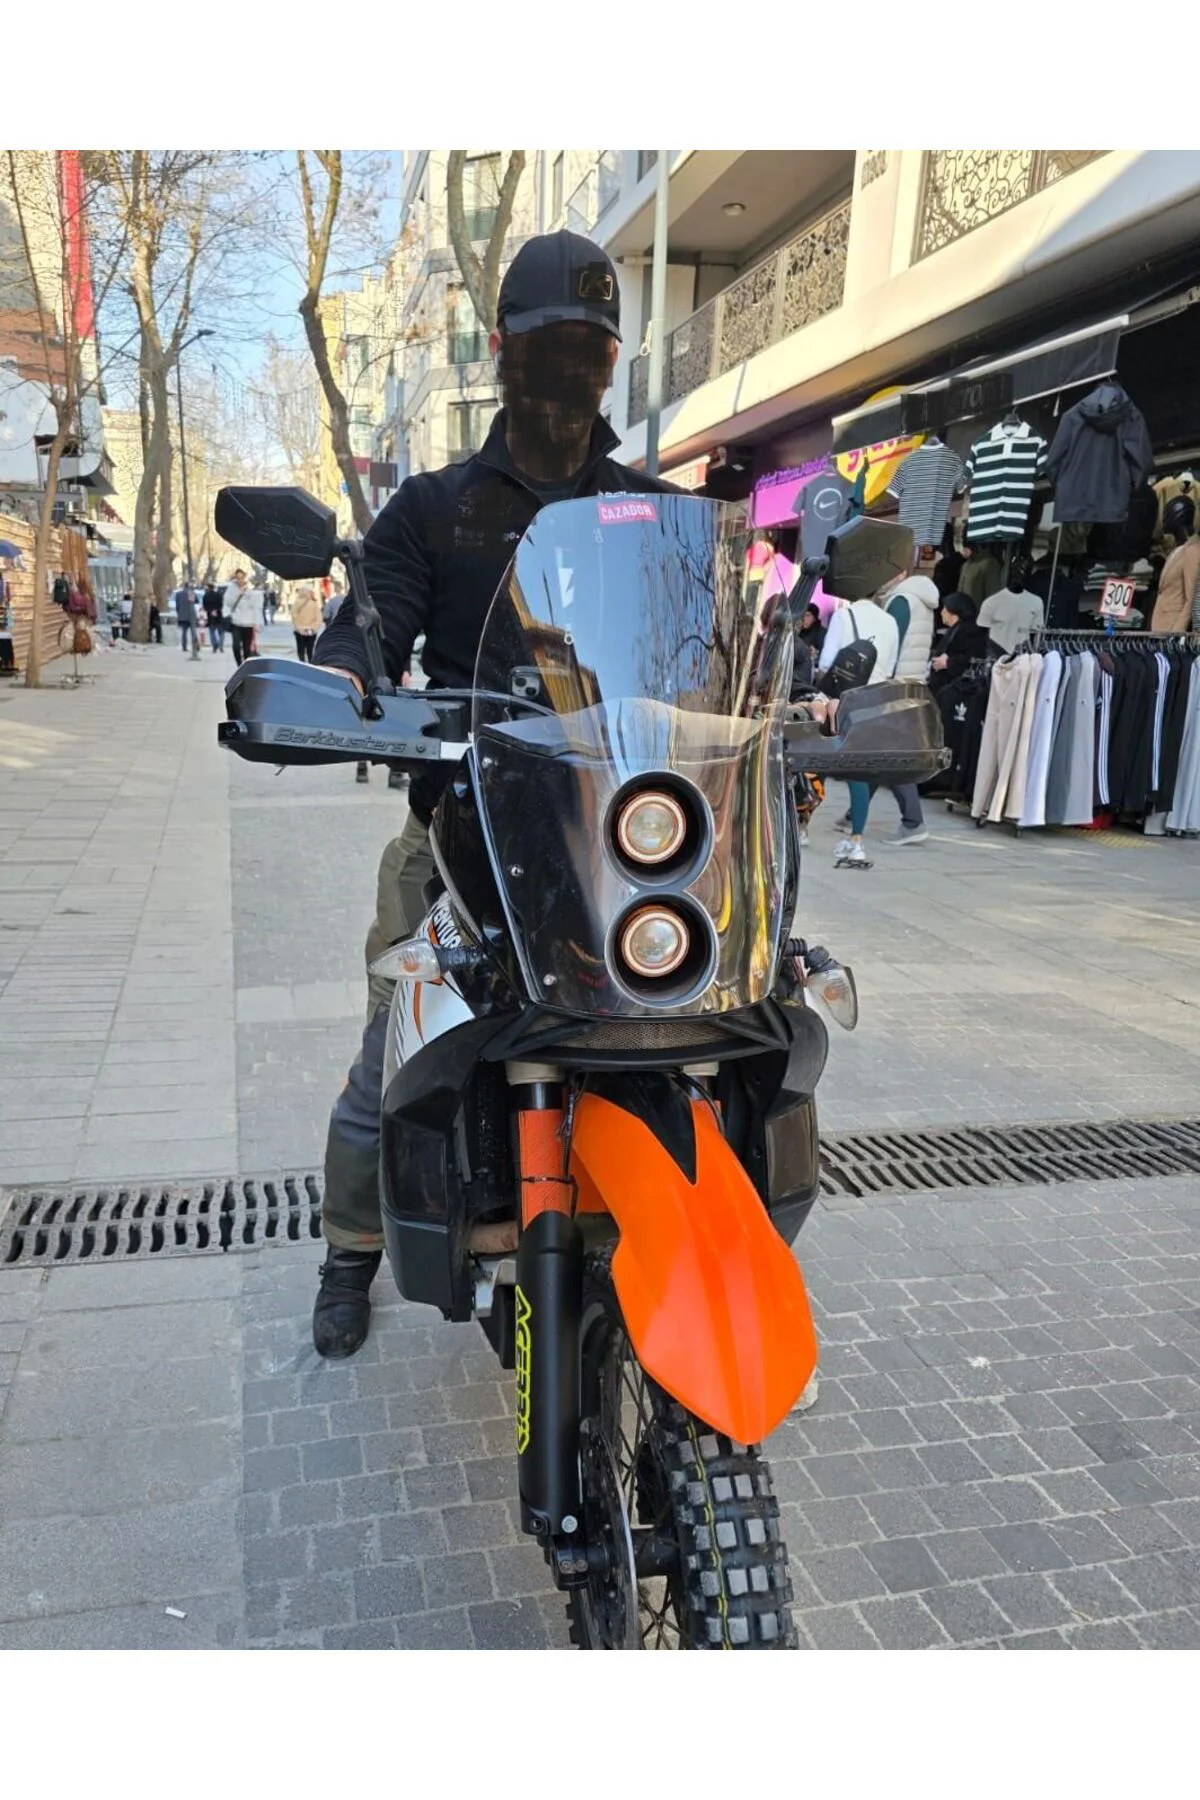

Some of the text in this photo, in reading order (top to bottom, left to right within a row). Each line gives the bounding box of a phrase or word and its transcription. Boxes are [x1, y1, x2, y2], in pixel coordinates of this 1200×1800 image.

[600, 503, 653, 520] CAZADOR
[1104, 582, 1132, 607] 300
[275, 727, 407, 753] Barkbusters
